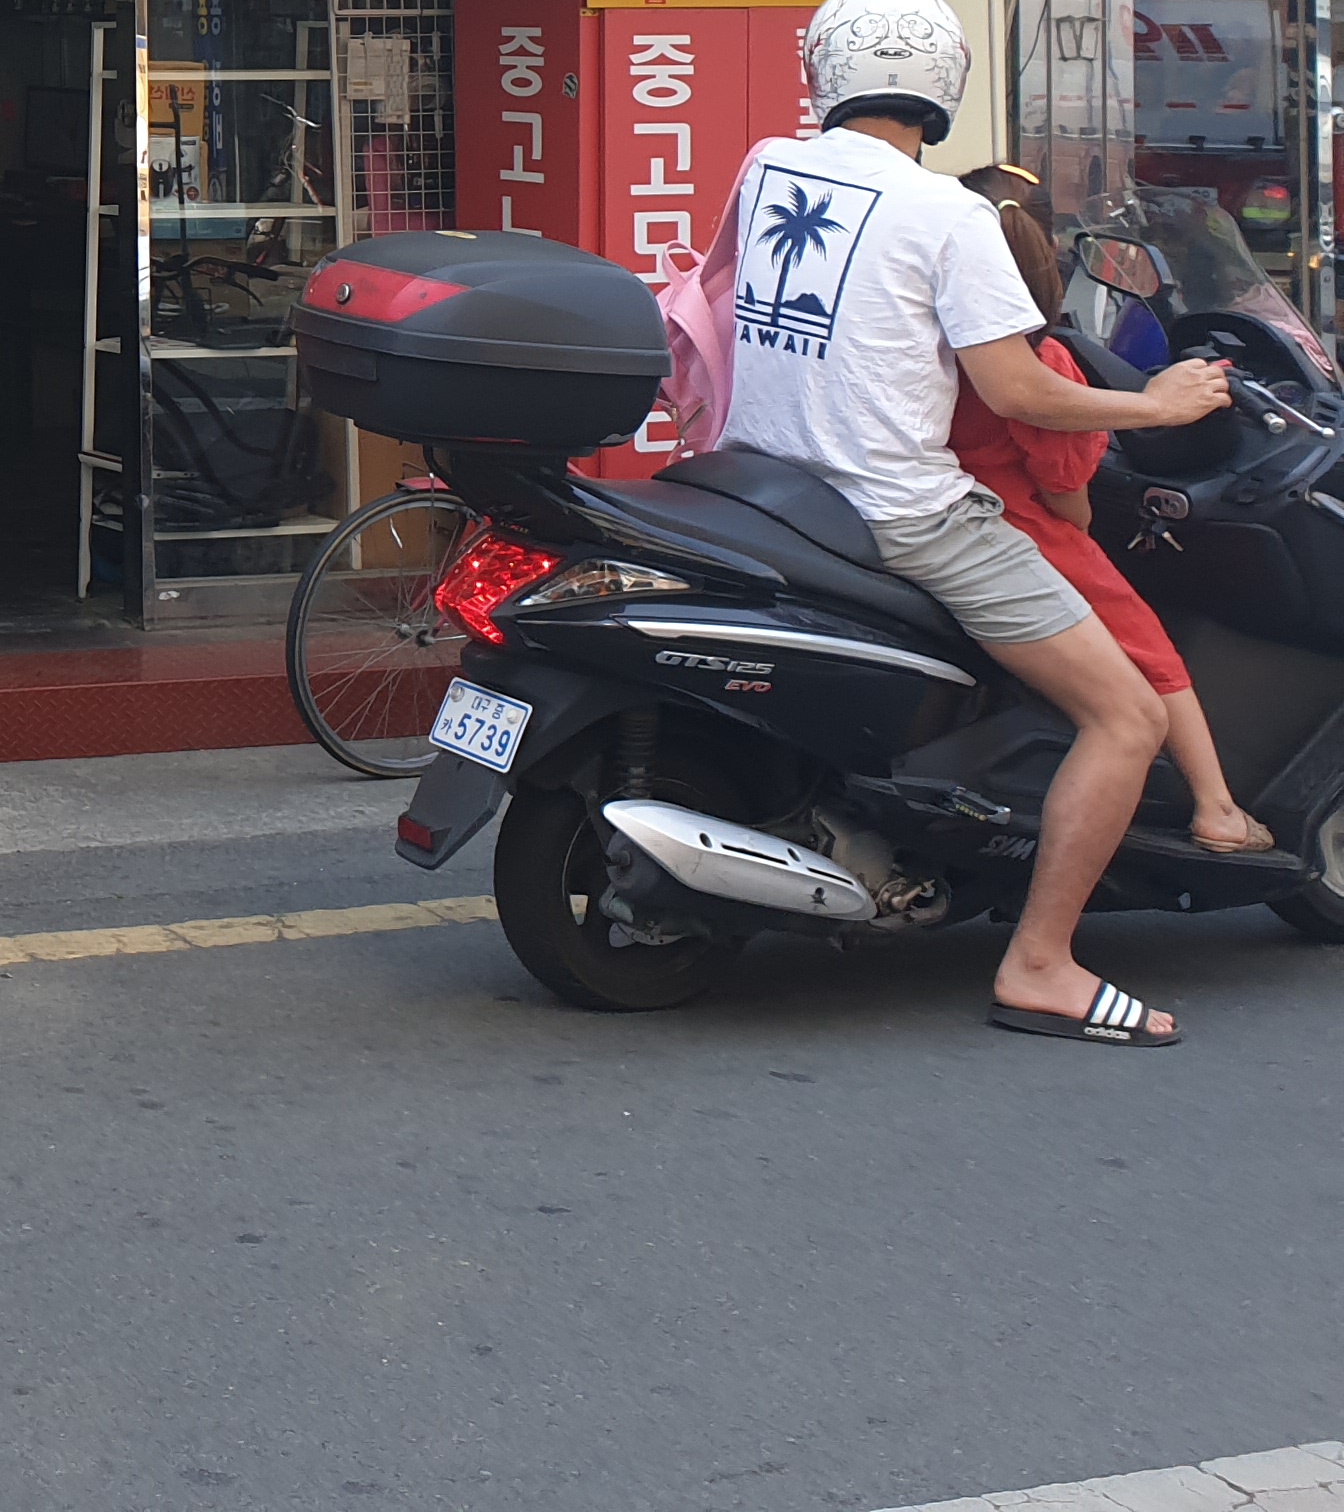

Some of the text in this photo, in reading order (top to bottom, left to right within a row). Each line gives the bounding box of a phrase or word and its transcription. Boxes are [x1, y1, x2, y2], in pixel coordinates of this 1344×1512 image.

[735, 324, 828, 361] AWAII
[724, 678, 773, 694] EVO
[470, 695, 491, 712] 대구
[454, 713, 511, 757] 5739
